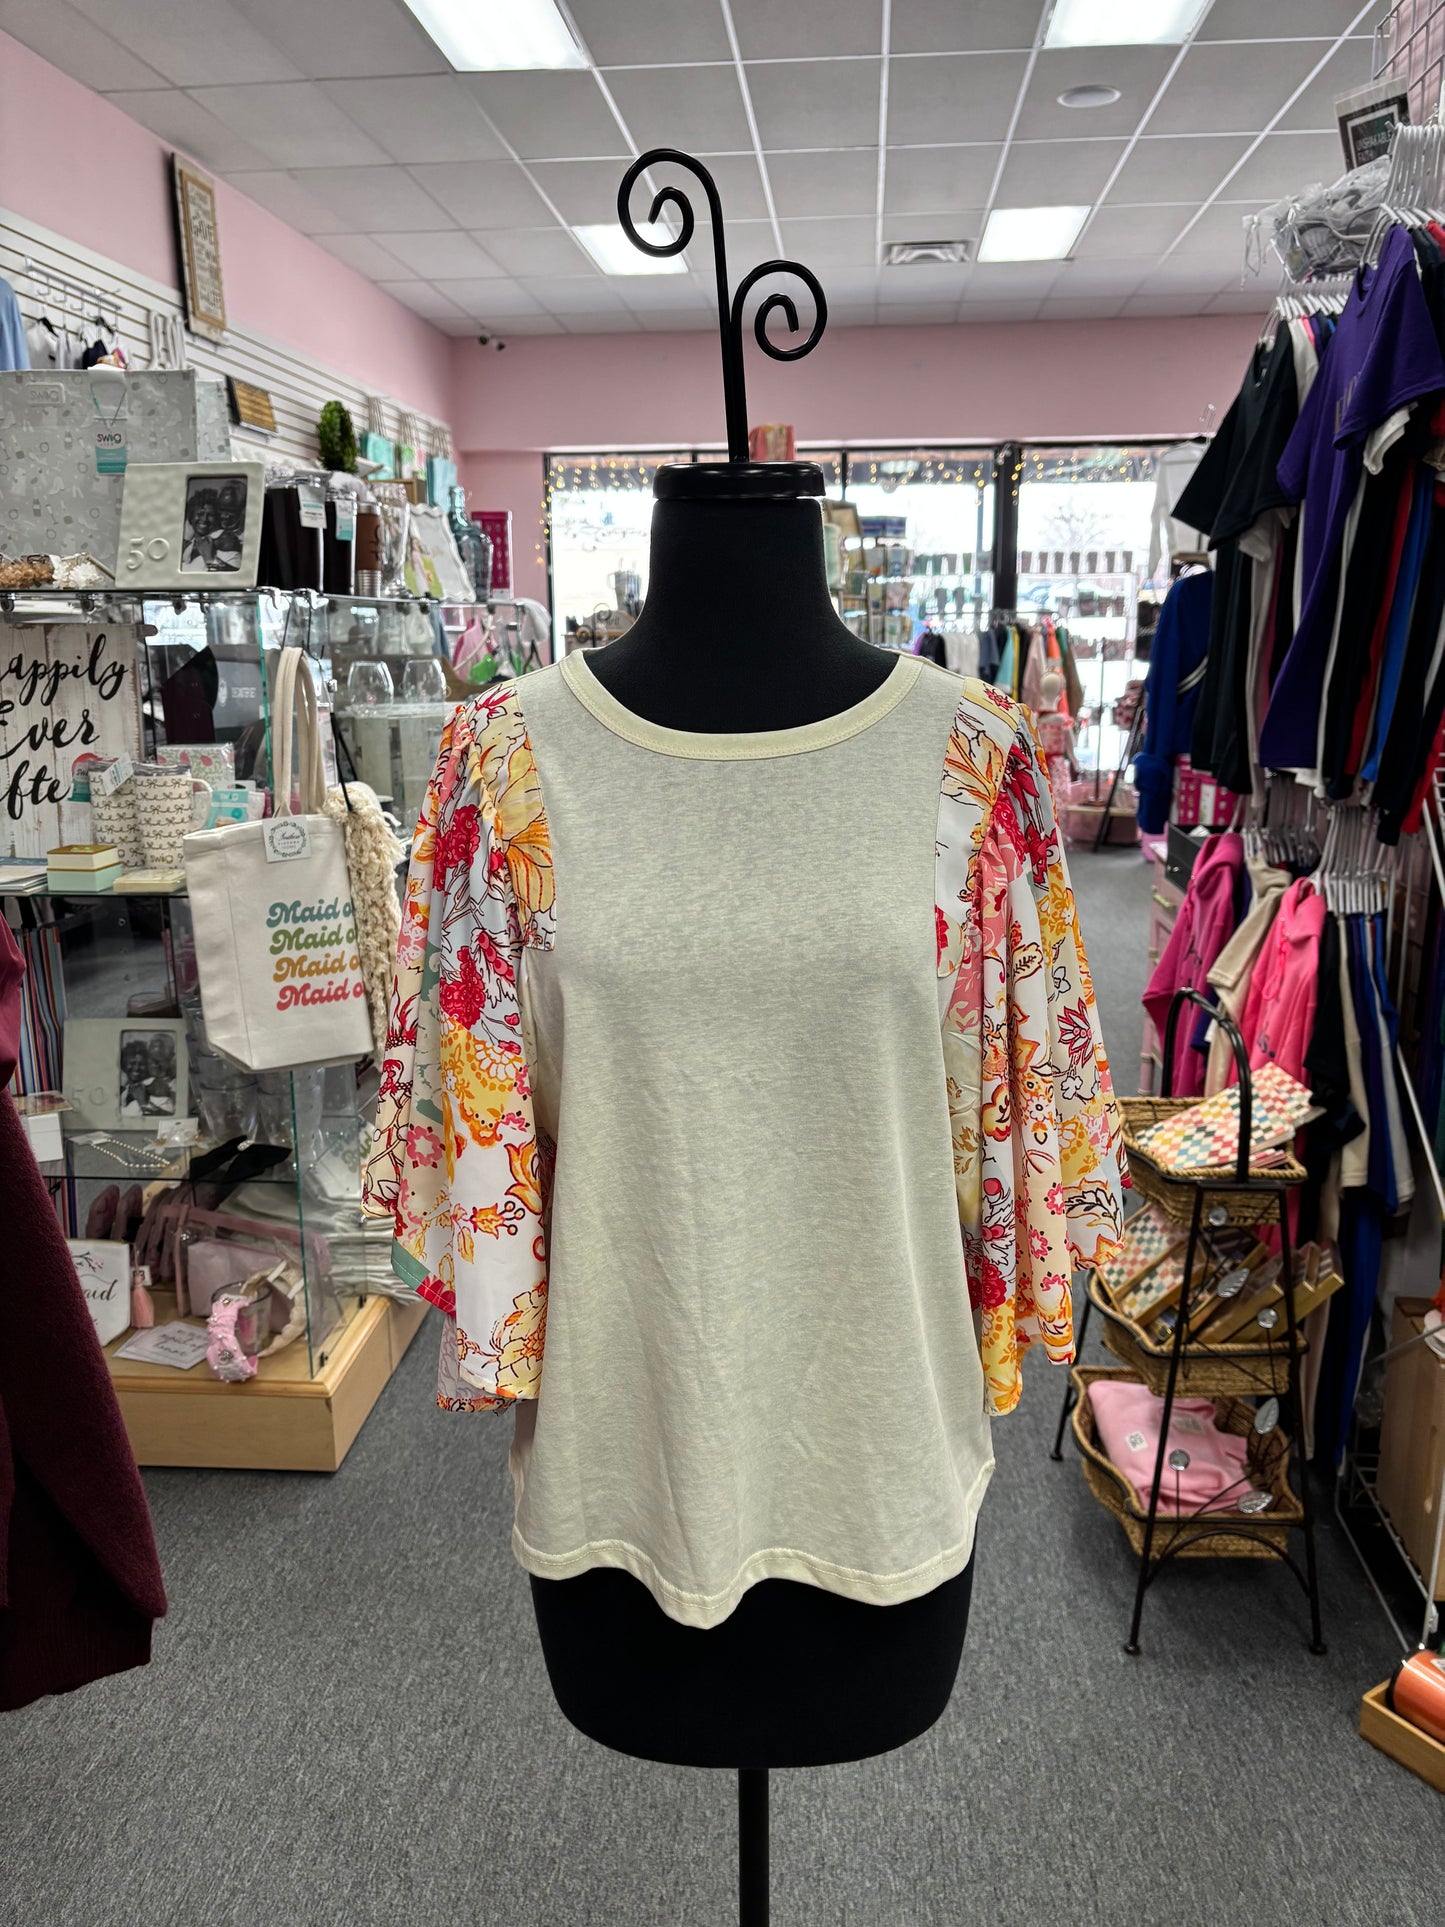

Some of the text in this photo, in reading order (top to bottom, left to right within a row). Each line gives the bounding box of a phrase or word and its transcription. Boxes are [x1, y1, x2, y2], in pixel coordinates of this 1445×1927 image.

[126, 536, 170, 570] 50
[0, 633, 128, 706] appily
[0, 760, 71, 820] fte
[266, 897, 353, 928] Maid o
[269, 923, 356, 955] Maid o
[273, 950, 361, 983] Maid o
[276, 977, 365, 1011] Maid o
[83, 1279, 118, 1301] aid
